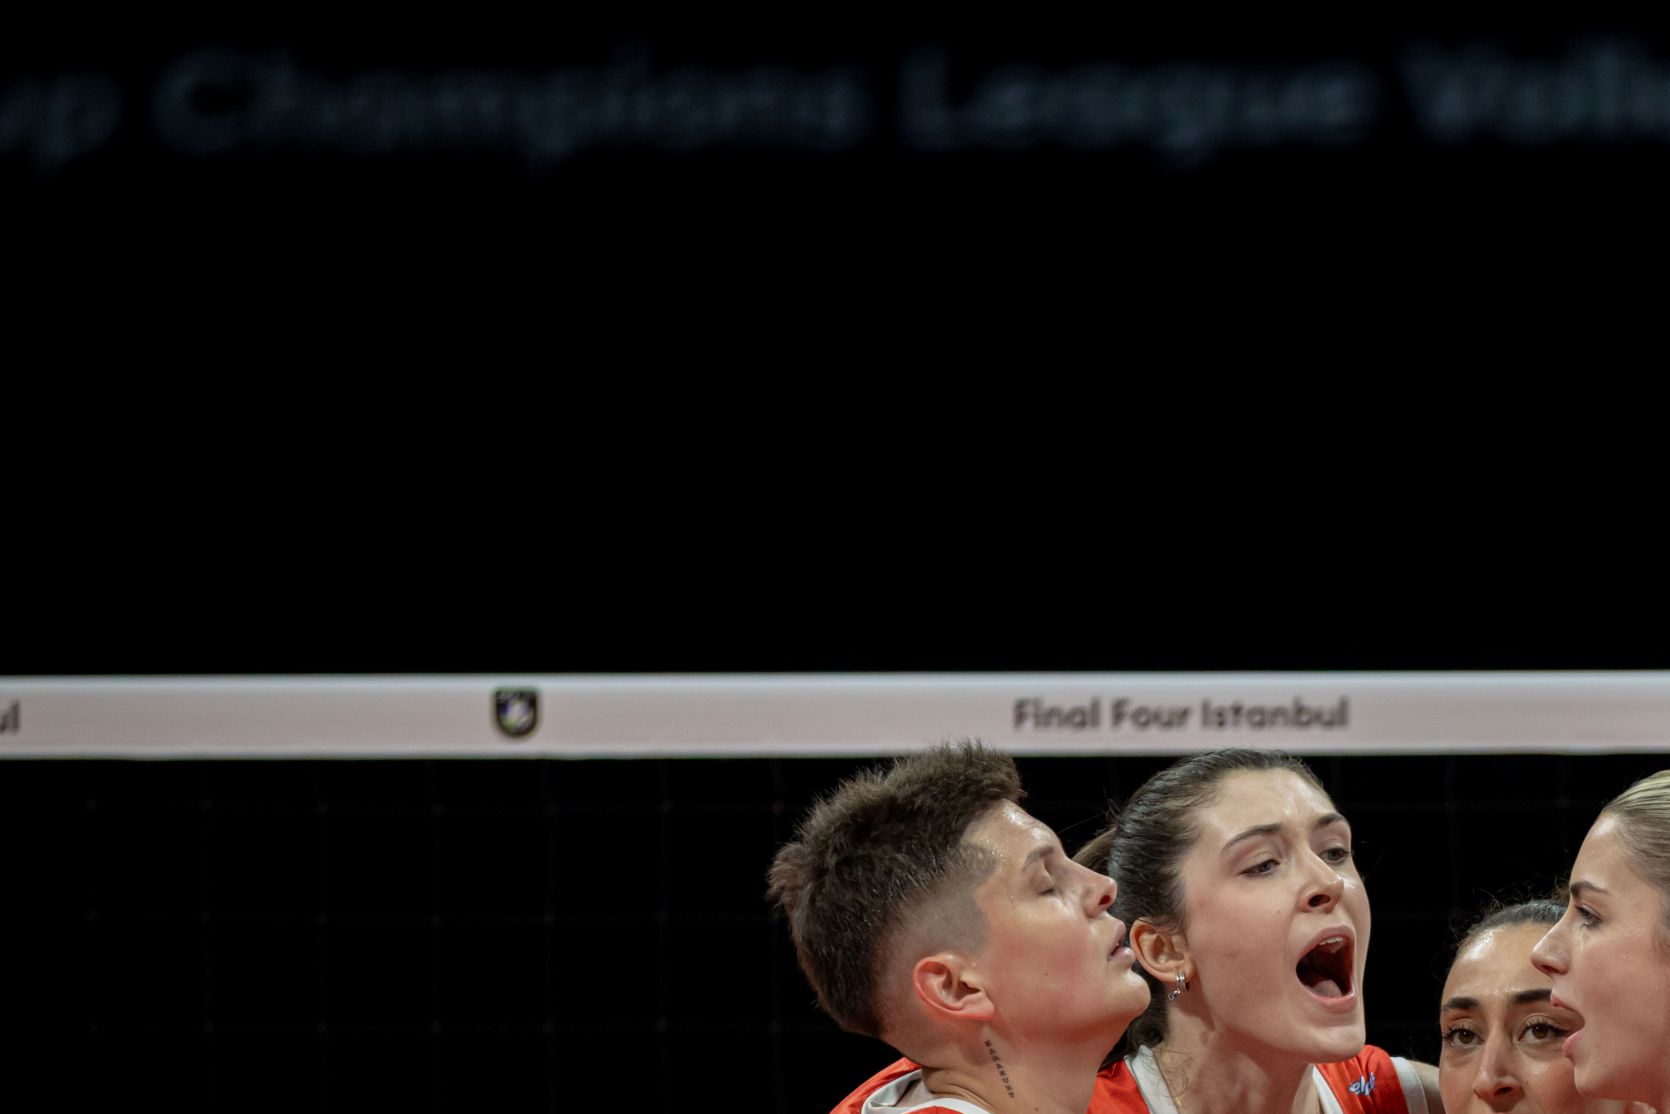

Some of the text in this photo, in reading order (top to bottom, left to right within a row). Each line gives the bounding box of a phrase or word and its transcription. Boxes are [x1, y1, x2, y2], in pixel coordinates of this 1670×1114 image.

[156, 50, 868, 163] Champions
[901, 48, 1376, 165] League
[1012, 696, 1348, 729] Final Four Istanbul
